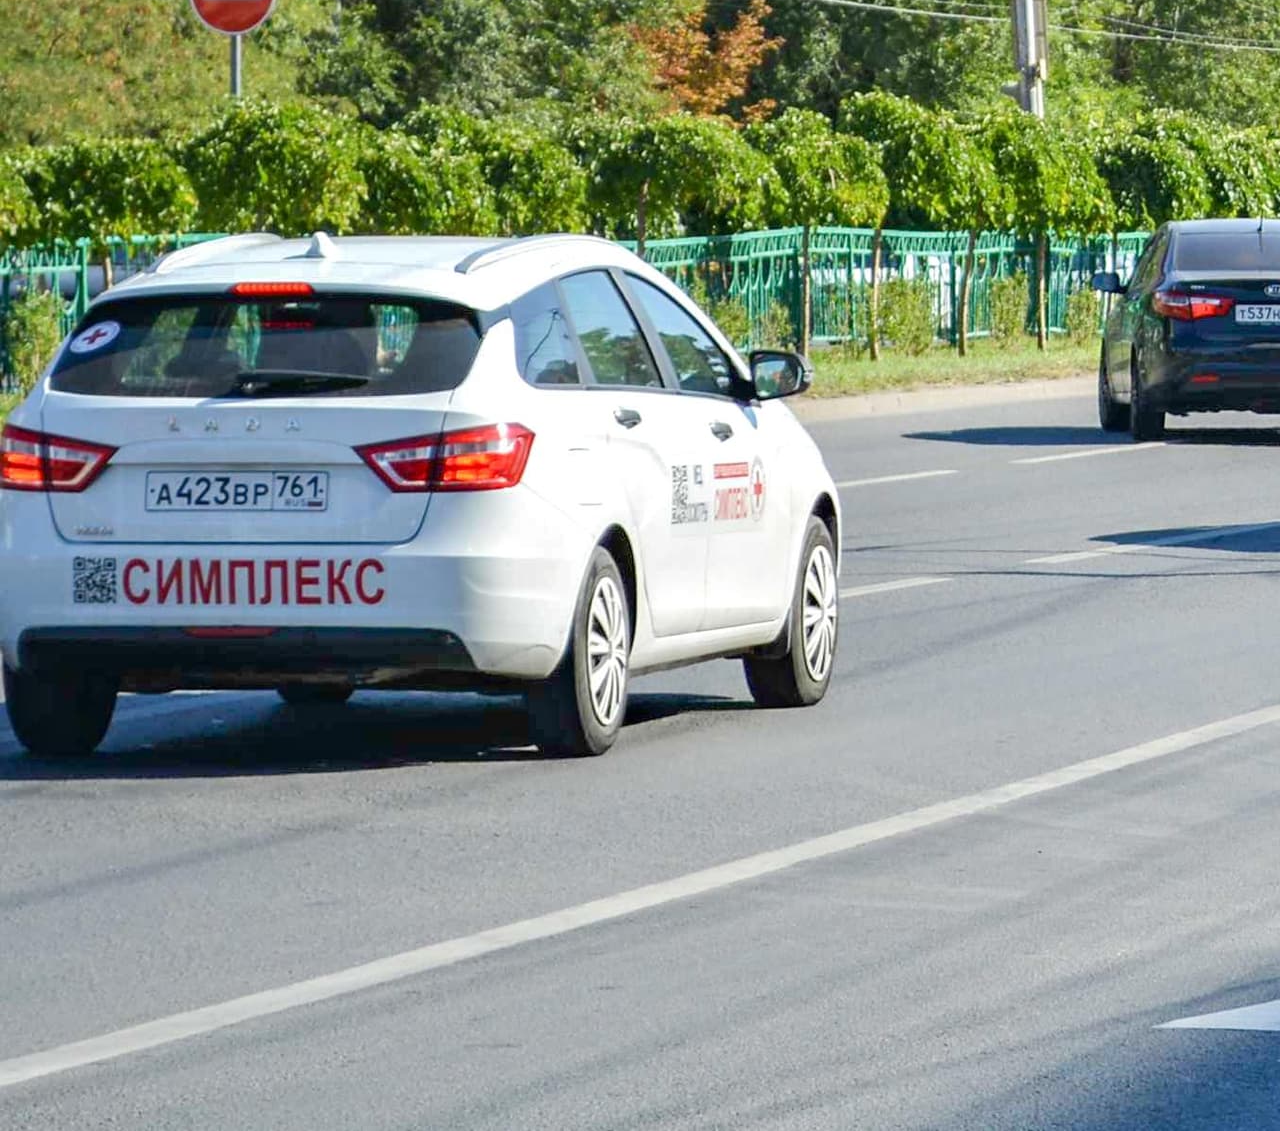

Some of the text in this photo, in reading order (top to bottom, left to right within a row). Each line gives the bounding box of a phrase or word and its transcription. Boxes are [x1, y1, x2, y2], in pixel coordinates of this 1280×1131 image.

[168, 415, 301, 432] LADA
[156, 475, 320, 506] А423ВР 761
[122, 557, 386, 606] СИМПЛЕКС
